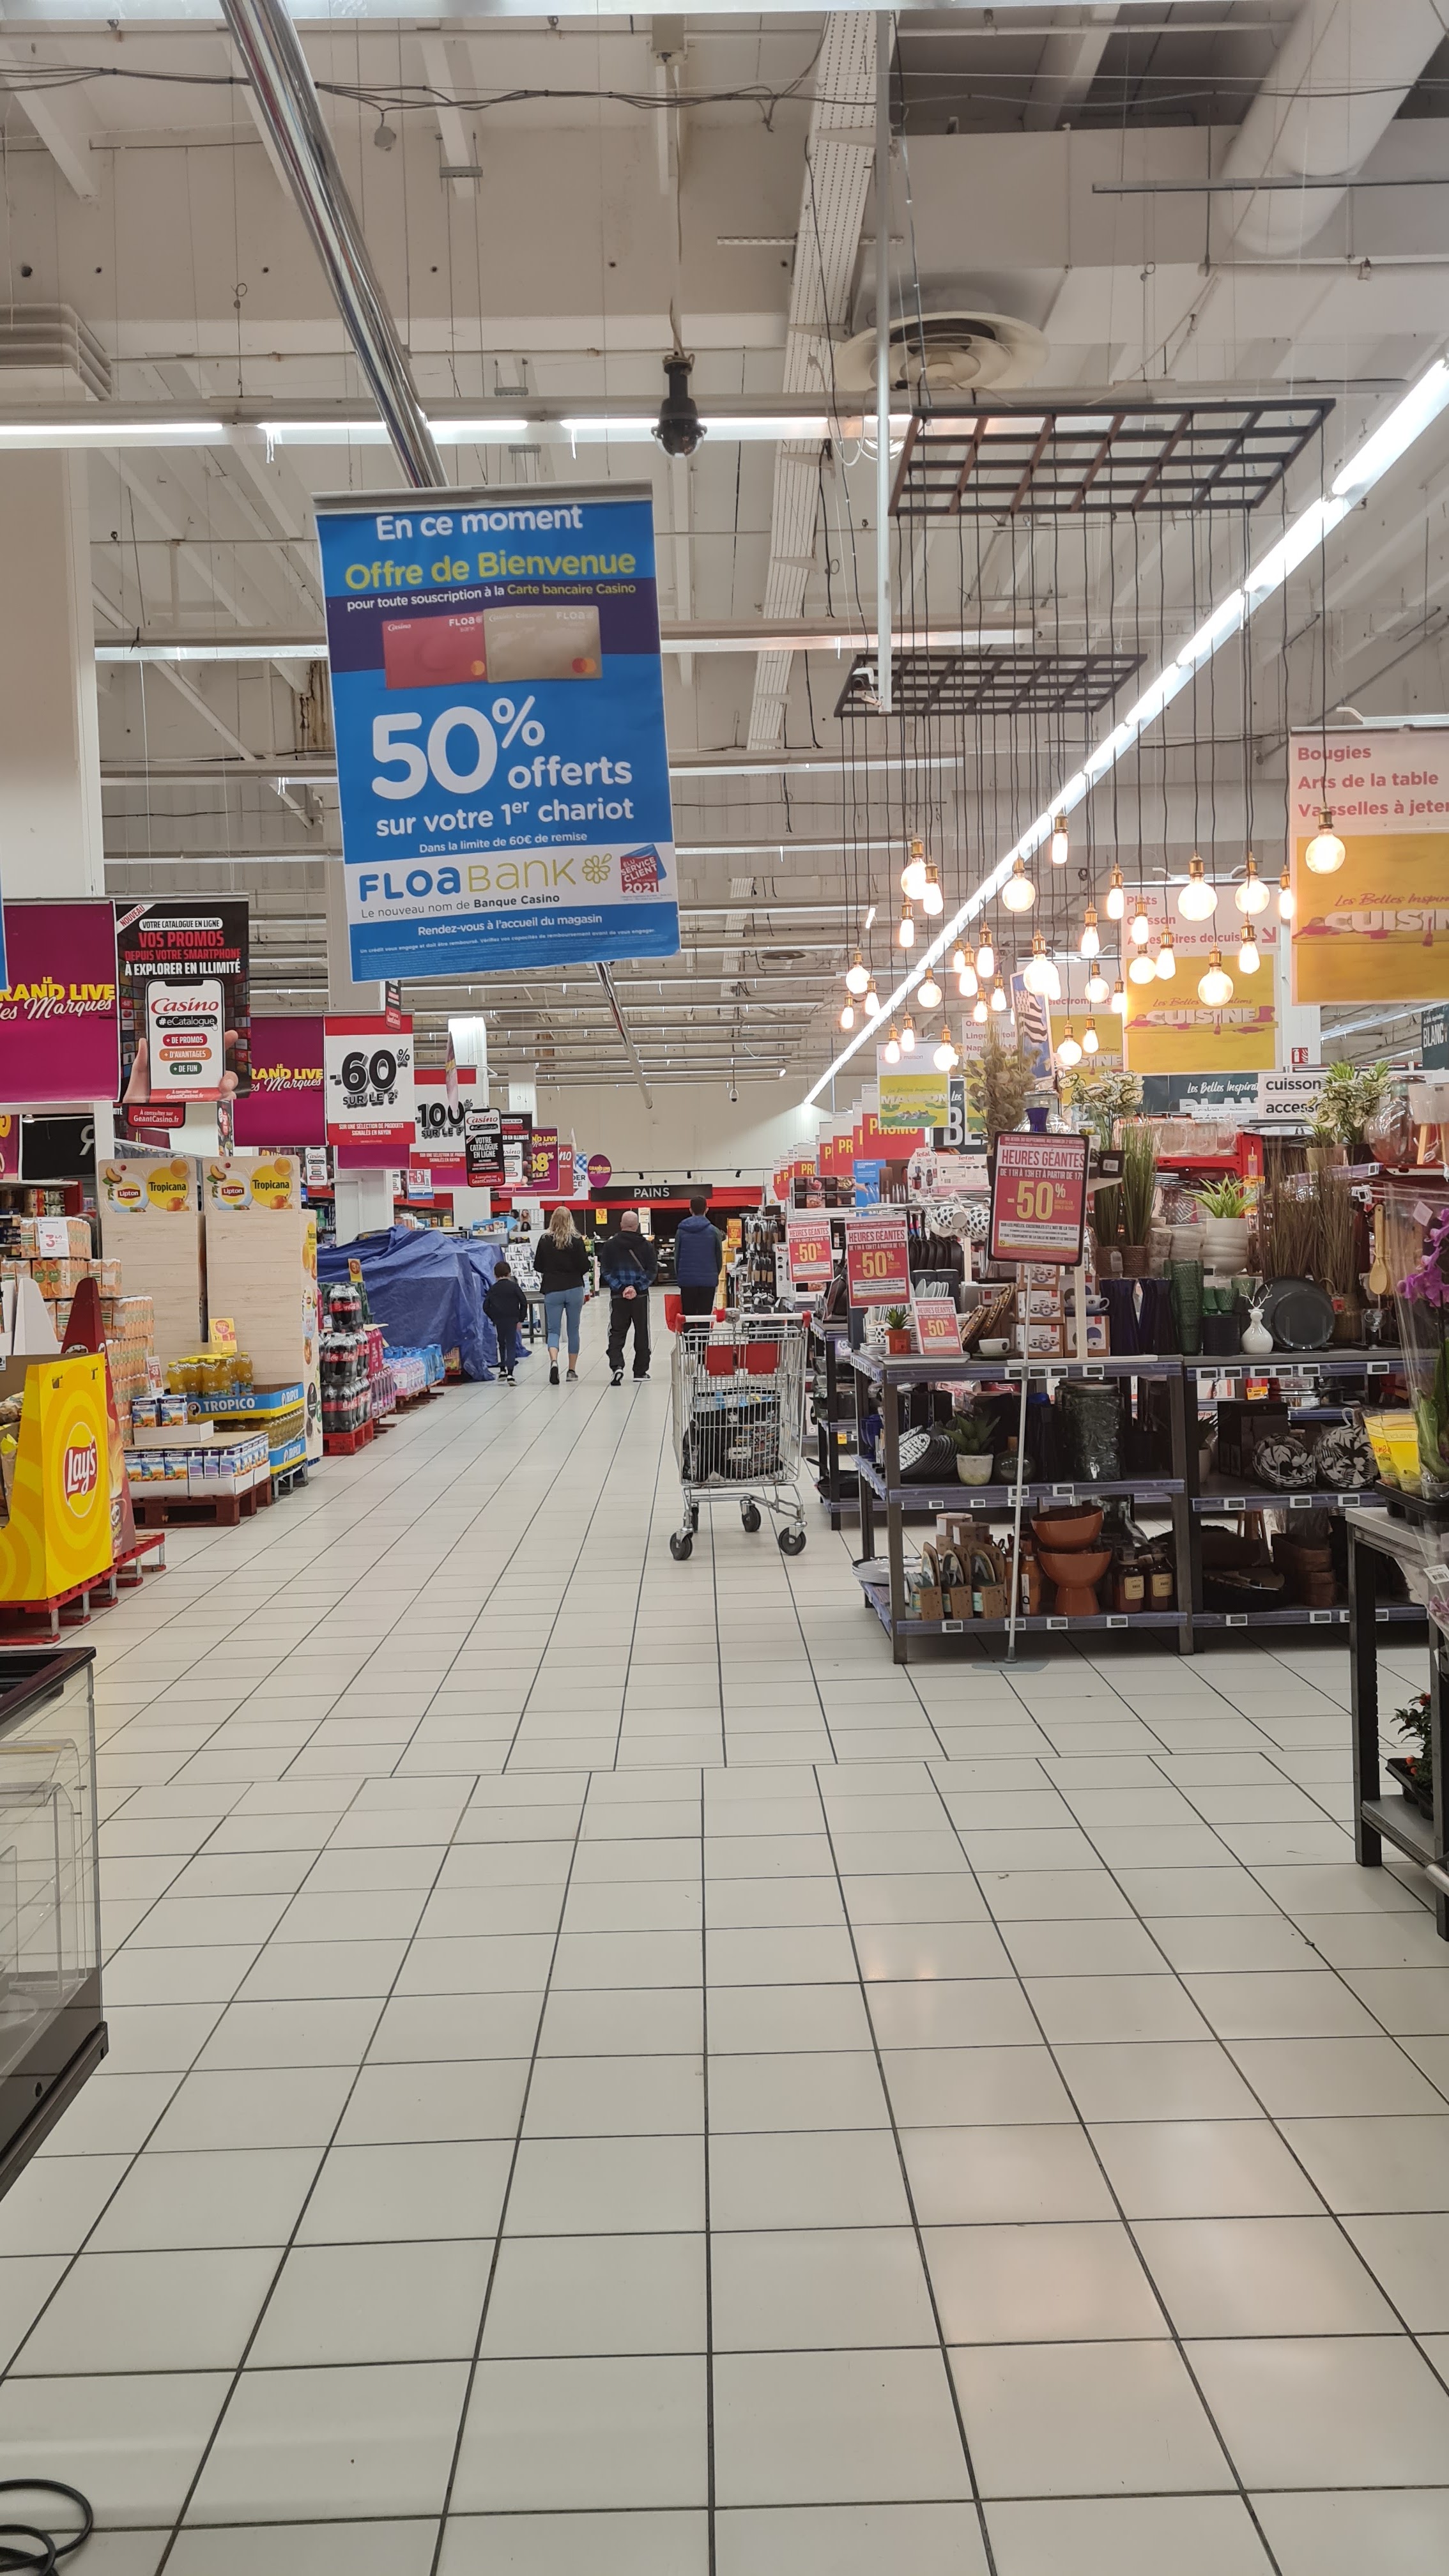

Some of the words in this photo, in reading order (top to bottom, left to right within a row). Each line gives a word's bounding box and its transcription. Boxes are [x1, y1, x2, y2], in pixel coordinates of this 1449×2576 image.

[376, 515, 412, 540] En
[420, 514, 453, 536] ce
[461, 504, 583, 534] moment
[345, 560, 423, 590] Offre
[431, 556, 470, 582] de
[478, 549, 636, 579] Bienvenue
[347, 597, 374, 611] pour
[377, 594, 408, 607] toute
[411, 588, 482, 606] souscription
[484, 586, 492, 597] à
[493, 585, 505, 596] la
[507, 583, 539, 595] Carte
[542, 583, 593, 595] bancaire
[595, 582, 636, 594] Casino
[388, 623, 411, 632] Casino
[371, 694, 546, 800] 50%
[1298, 746, 1372, 762] Bougies
[507, 755, 632, 790] offerts
[1298, 775, 1337, 790] Arts
[1341, 774, 1365, 788] de
[1370, 773, 1386, 787] la
[1392, 770, 1439, 786] table
[1298, 800, 1389, 817] Vasselles
[1394, 799, 1404, 815] à
[376, 813, 417, 837] sur
[424, 807, 493, 832] votre
[501, 800, 530, 825] 1er
[538, 797, 634, 823] chariot
[419, 843, 446, 854] Dans
[448, 841, 457, 850] la
[460, 839, 490, 850] limite
[493, 838, 507, 847] de
[509, 835, 532, 846] 60€
[534, 833, 548, 843] de
[551, 832, 588, 842] remise
[620, 857, 656, 876] SERVICE
[624, 864, 657, 882] CLIENT
[624, 882, 657, 893] 2021
[361, 909, 374, 919] Le
[378, 905, 424, 917] nouveau
[428, 903, 452, 912] nom
[456, 900, 470, 910] de
[474, 897, 517, 910] Banque
[521, 894, 560, 905] Casino
[1126, 896, 1158, 906] Plts
[1334, 894, 1354, 907] Les
[1360, 893, 1403, 906] Belles
[119, 904, 146, 927] NOUVEAU
[1126, 916, 1176, 925] Csson
[142, 921, 160, 929] VOTRE
[162, 920, 193, 928] CATALOGUE
[418, 924, 484, 936] Rendez-vous
[487, 920, 494, 930] à
[540, 916, 555, 926] du
[557, 914, 602, 926] magasin
[138, 931, 164, 948] VOS
[167, 930, 225, 947] PROMOS
[1194, 933, 1214, 943] de
[125, 950, 155, 962] DEPUIS
[155, 949, 182, 960] VOTRE
[183, 948, 241, 960] SMARTPHONE
[125, 960, 132, 976] À
[134, 962, 183, 976] EXPLORER
[185, 962, 197, 974] EN
[199, 958, 241, 974] ILLIMITÉ
[42, 976, 52, 985] LE
[0, 984, 65, 1002] RAND
[70, 984, 116, 1000] LIVE
[0, 1004, 17, 1020] es
[24, 997, 112, 1021] Marques
[151, 997, 219, 1015] Casino
[1152, 998, 1168, 1007] Les
[1171, 996, 1200, 1006] Belles
[158, 1016, 215, 1027] #eCatalogue
[1145, 1008, 1255, 1025] CUISINE
[1423, 1022, 1445, 1048] BLANC
[169, 1050, 206, 1059] D'AVANTAGES
[252, 1068, 291, 1080] RAND
[295, 1068, 323, 1080] LIVE
[264, 1077, 321, 1092] Marques
[1187, 1082, 1199, 1094] Les
[1200, 1081, 1224, 1094] Belles
[1226, 1080, 1259, 1096] Inspirat
[1266, 1078, 1322, 1090] cuisson
[343, 1094, 364, 1106] SUR
[369, 1093, 384, 1103] LE
[951, 1091, 962, 1102] Les
[134, 1114, 179, 1123] GeantCasino.fr
[466, 1116, 498, 1124] Casino
[470, 1143, 498, 1152] CATALOGUE
[1001, 1149, 1040, 1166] HEURES
[1042, 1149, 1085, 1169] GÉANTES
[1000, 1168, 1008, 1176] DE
[1009, 1169, 1018, 1177] 11H
[1025, 1169, 1034, 1177] 13H
[1042, 1168, 1048, 1178] À
[1047, 1170, 1066, 1179] PARTIR
[1066, 1172, 1073, 1180] DE
[148, 1181, 187, 1193] Tropicana
[223, 1187, 244, 1195] Lipton
[252, 1179, 290, 1191] Tropicana
[634, 1187, 670, 1198] PAINS
[1007, 1180, 1066, 1220] -50%
[848, 1232, 875, 1243] HEURES
[875, 1229, 905, 1241] GÉANTES
[855, 1250, 894, 1278] -50%
[203, 1397, 255, 1412] TROPICO
[66, 1440, 96, 1496] Lay's
